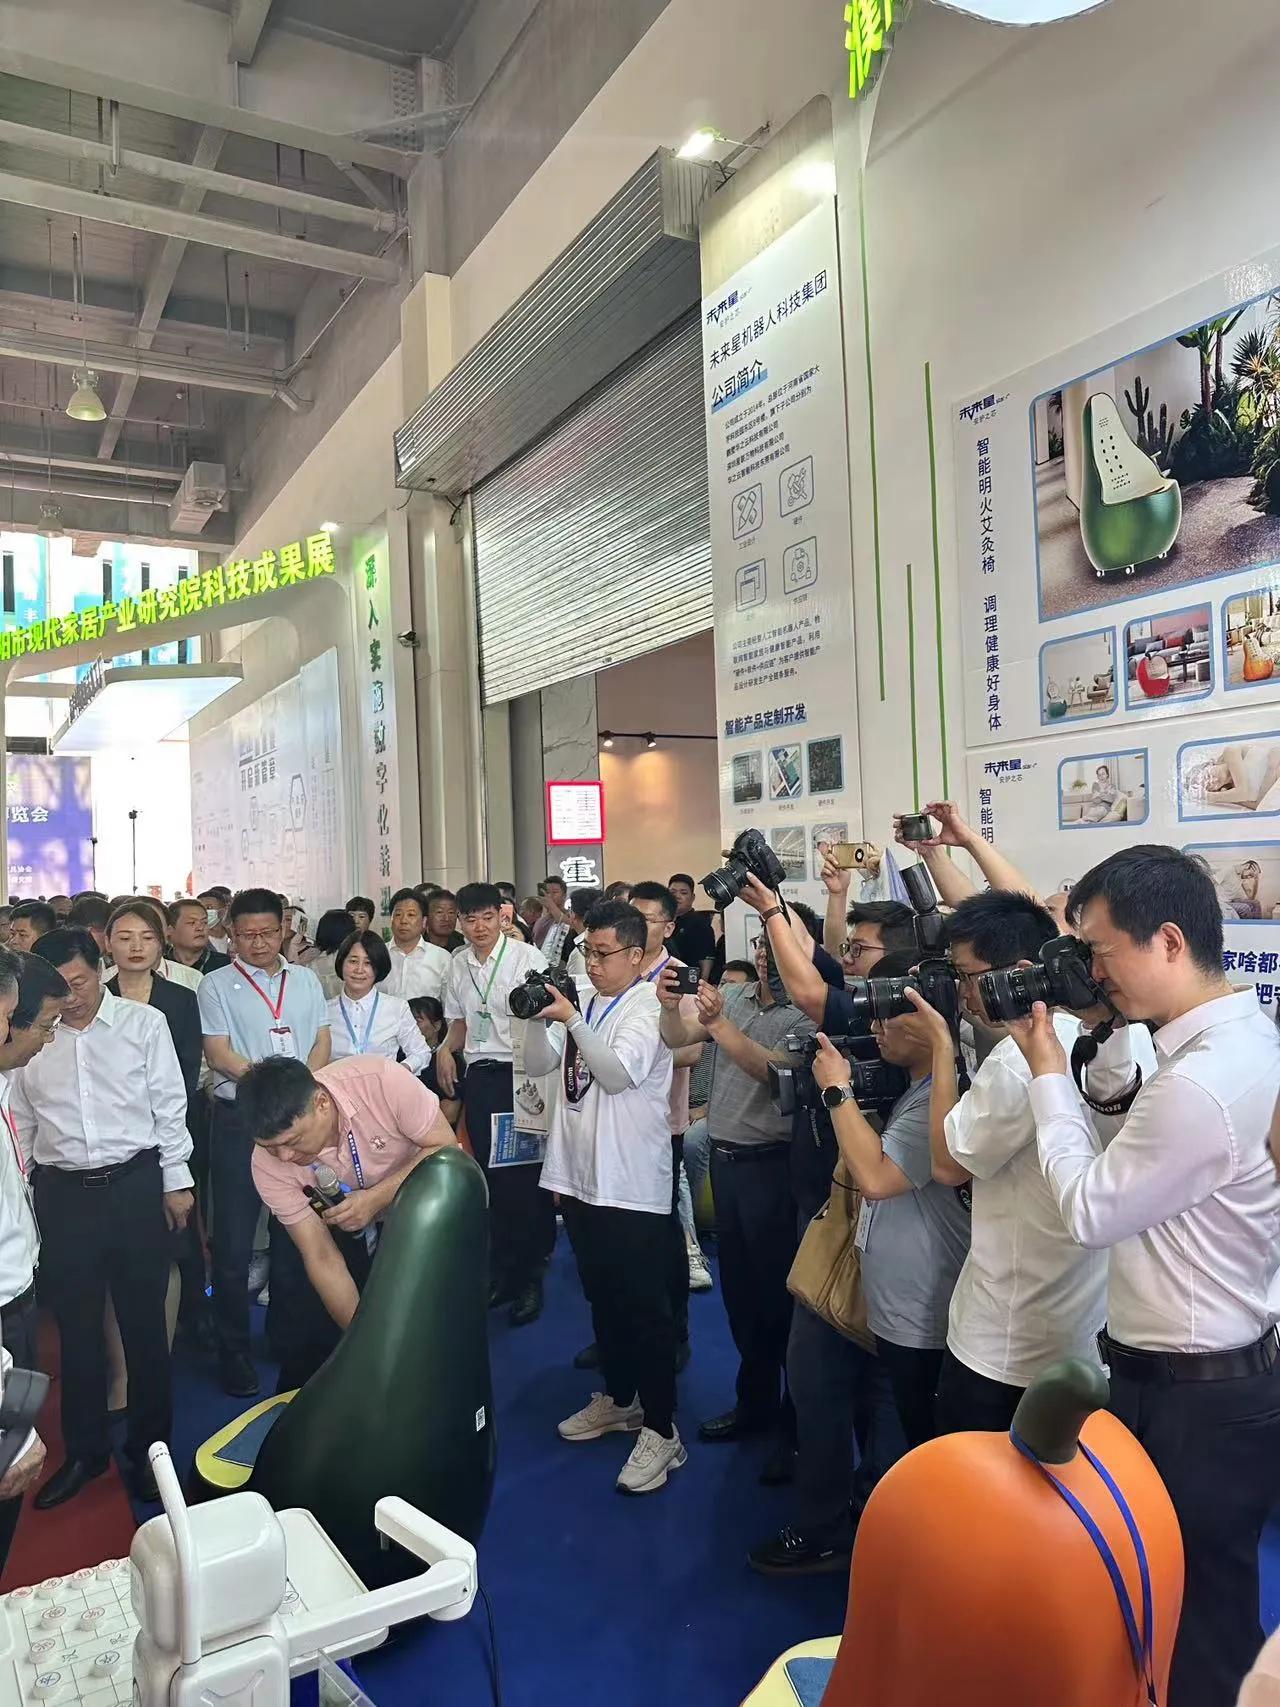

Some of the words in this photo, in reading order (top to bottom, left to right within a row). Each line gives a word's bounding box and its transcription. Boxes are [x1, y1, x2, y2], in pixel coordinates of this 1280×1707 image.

[709, 269, 827, 370] 未来星机器人科技集团
[712, 359, 763, 407] 公司简介
[959, 394, 995, 420] 未来星
[976, 437, 996, 574] 智能明火艾灸椅
[983, 594, 1002, 731] 调理健康好身体
[725, 702, 806, 736] 智能产品定制开发
[984, 759, 1022, 777] 未来星
[6, 806, 49, 823] 览会
[1222, 950, 1280, 974] 家啥都
[567, 1066, 575, 1092] Canon
